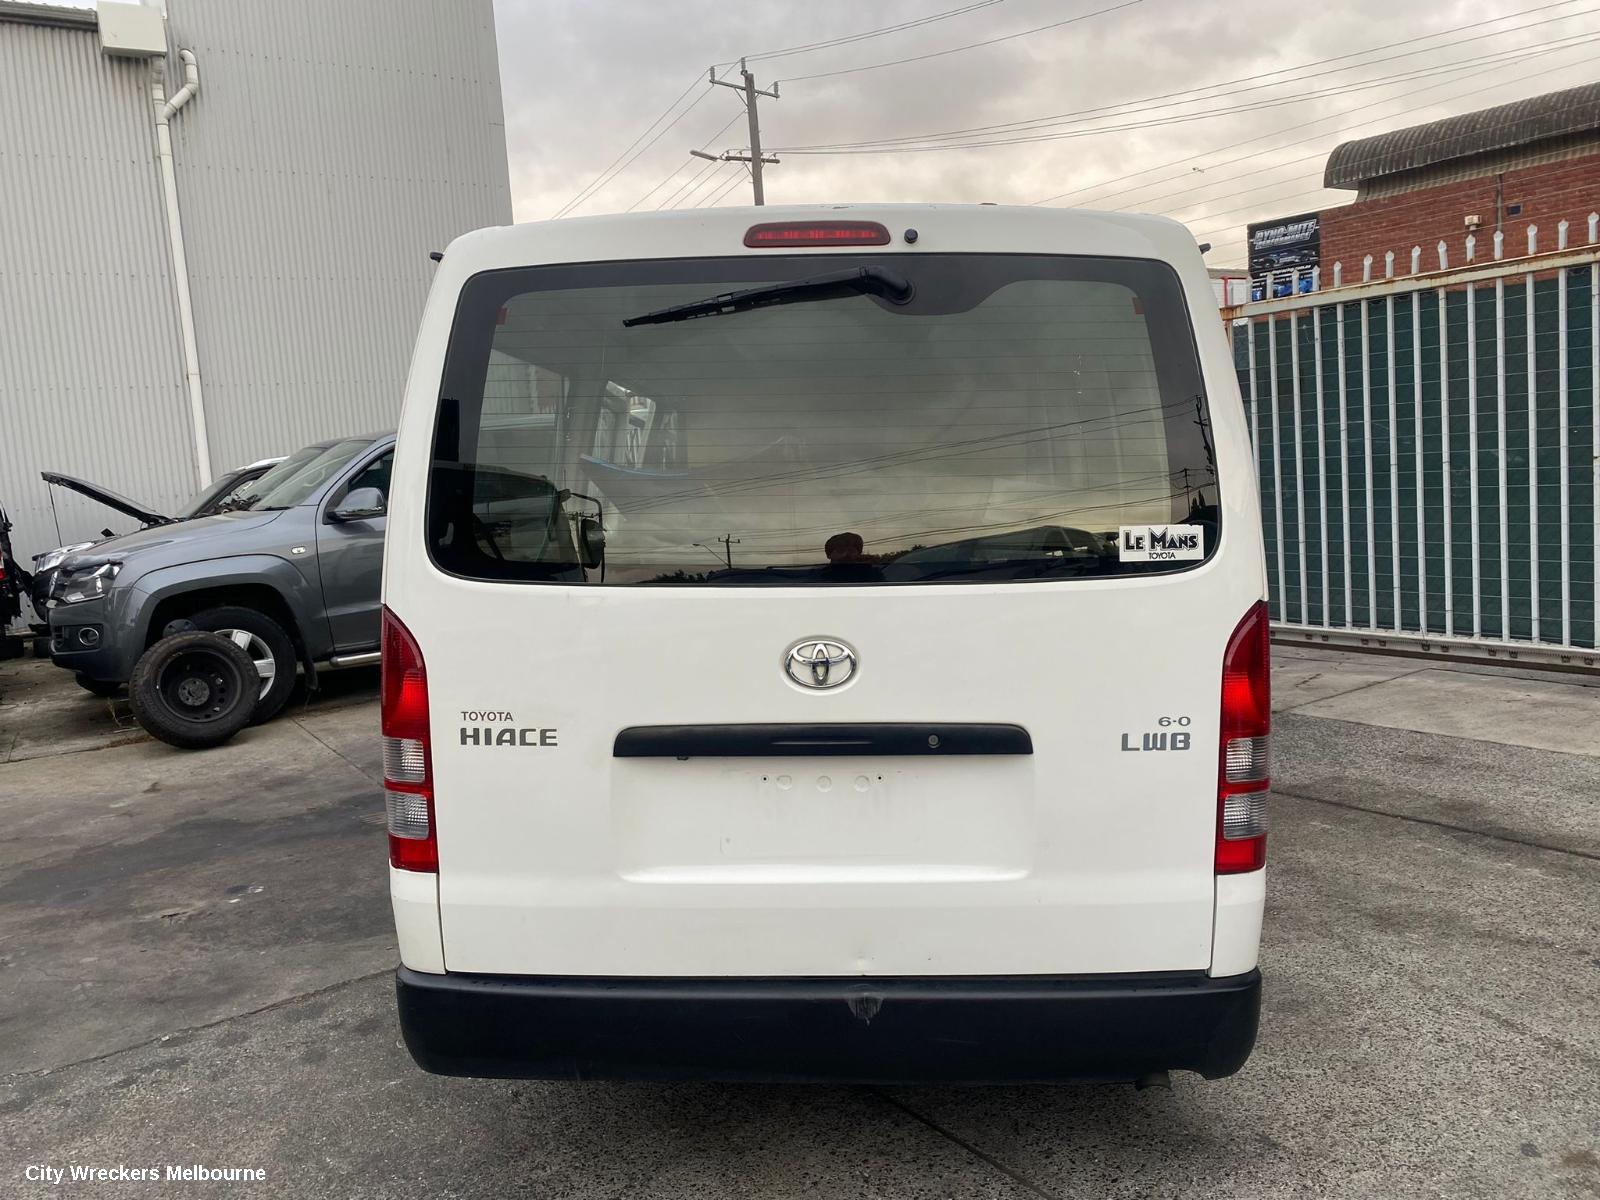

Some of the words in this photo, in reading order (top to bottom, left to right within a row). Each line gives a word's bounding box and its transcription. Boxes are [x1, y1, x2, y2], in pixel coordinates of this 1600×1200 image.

[1123, 530, 1145, 552] LE
[1148, 527, 1199, 552] MANS
[460, 711, 514, 721] TOYOTA
[460, 727, 558, 746] HIACE
[1121, 732, 1191, 751] LWB
